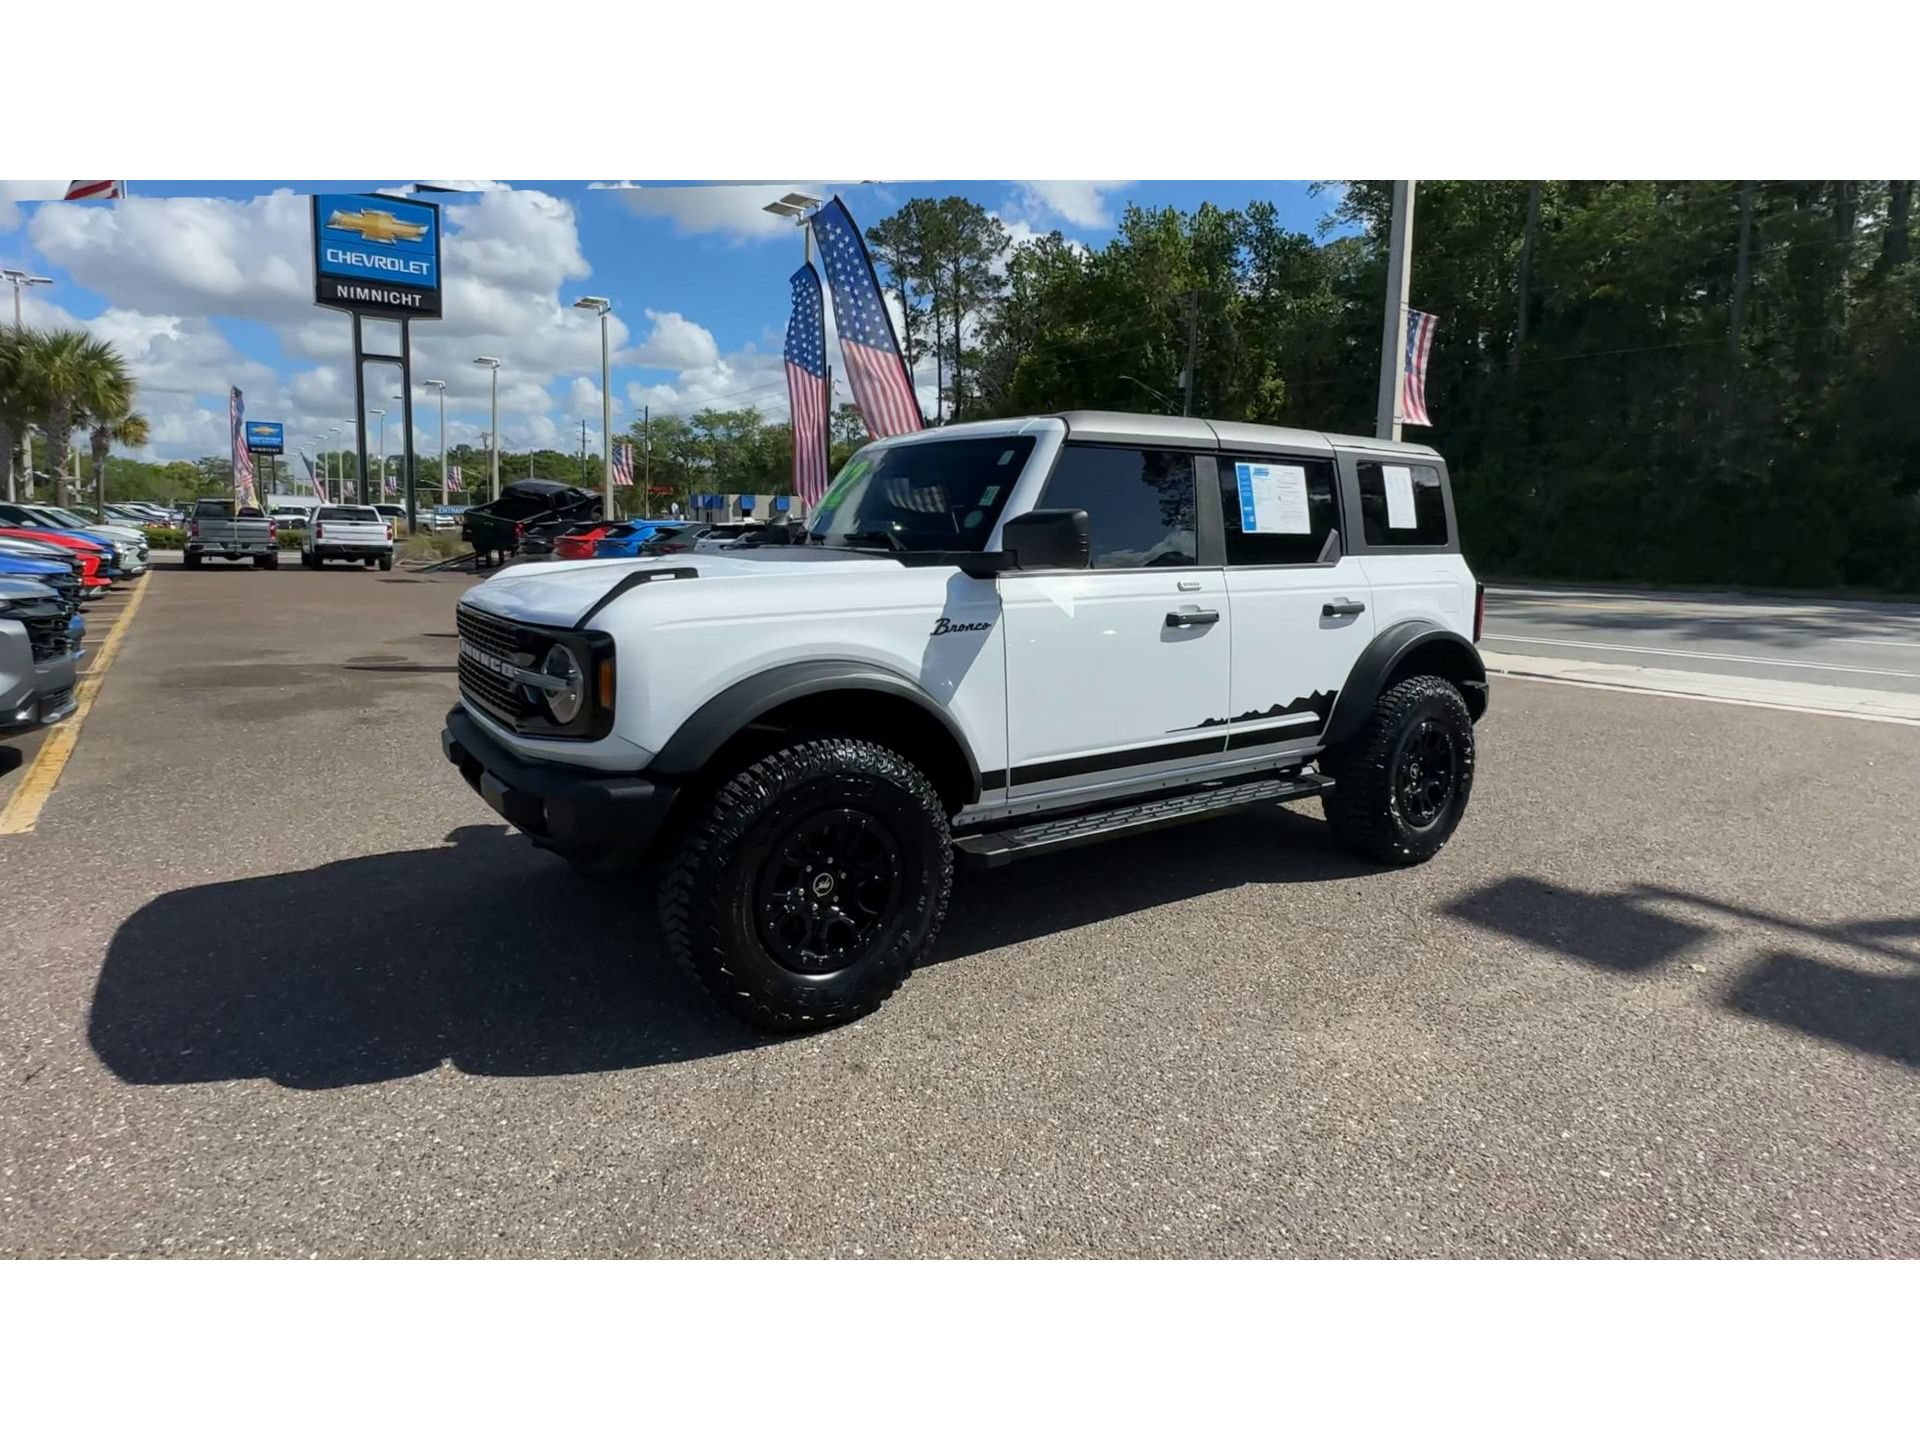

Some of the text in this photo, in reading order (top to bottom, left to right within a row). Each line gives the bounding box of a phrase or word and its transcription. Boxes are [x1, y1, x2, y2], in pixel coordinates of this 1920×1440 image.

[326, 248, 430, 275] CHEVROLET
[337, 285, 421, 307] NIMNICHT
[929, 617, 992, 636] Bronco
